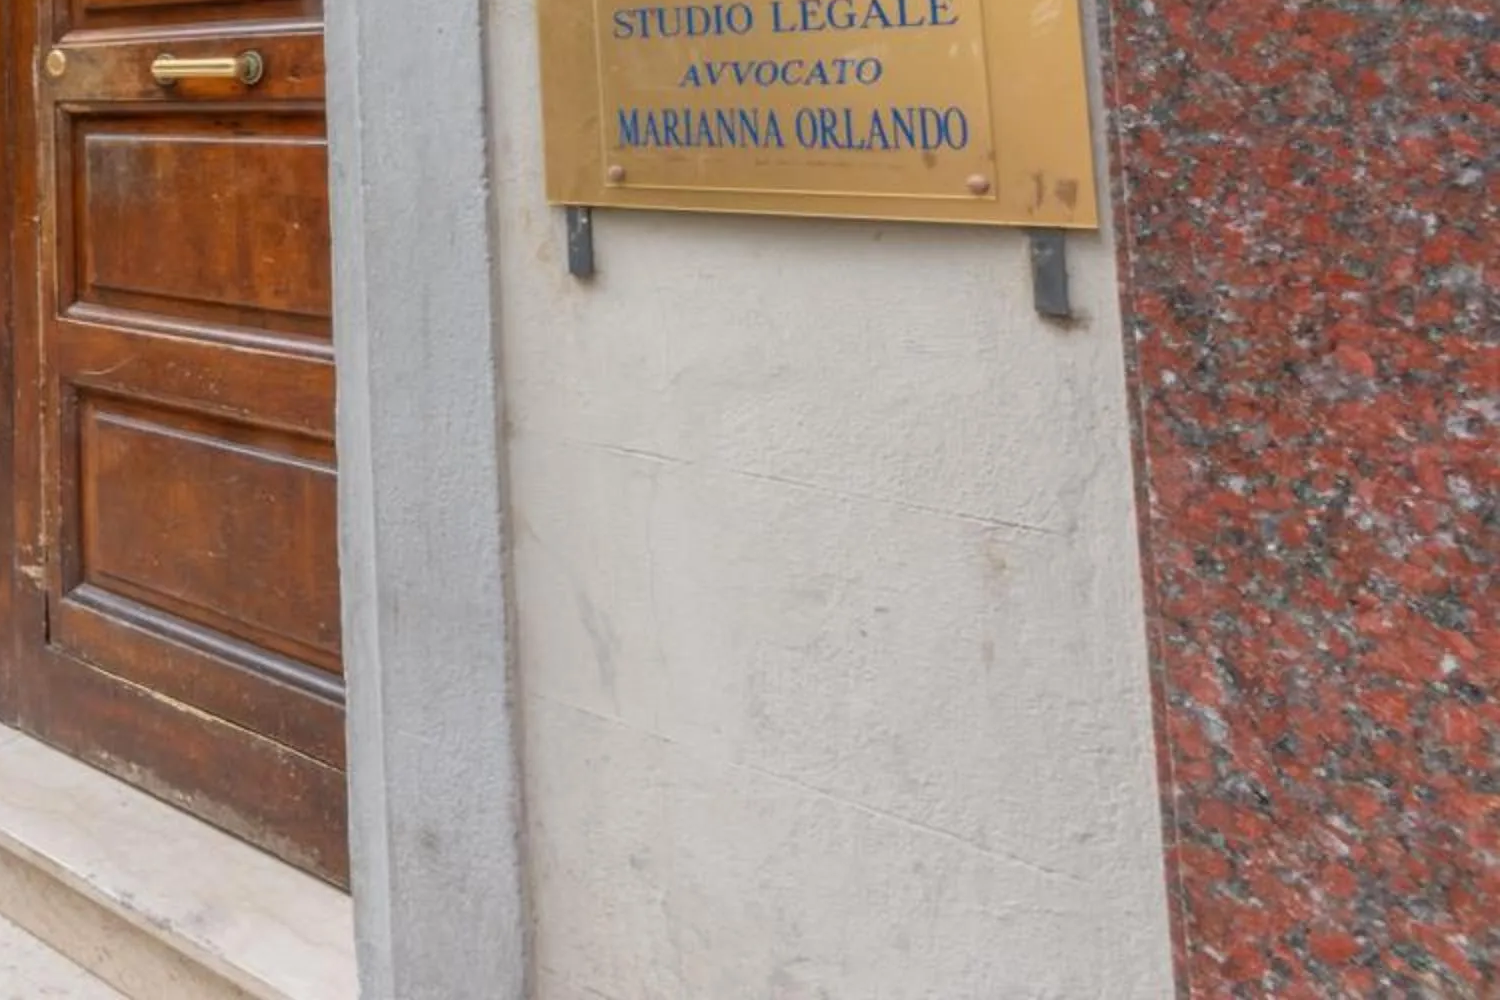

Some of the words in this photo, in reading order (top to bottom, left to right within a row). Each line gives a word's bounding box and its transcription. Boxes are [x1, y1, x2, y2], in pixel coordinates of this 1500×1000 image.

[612, 2, 754, 39] STUDIO
[677, 56, 884, 88] AVVOCATO
[616, 106, 786, 150] MARIANNA
[794, 106, 970, 152] ORLANDO
